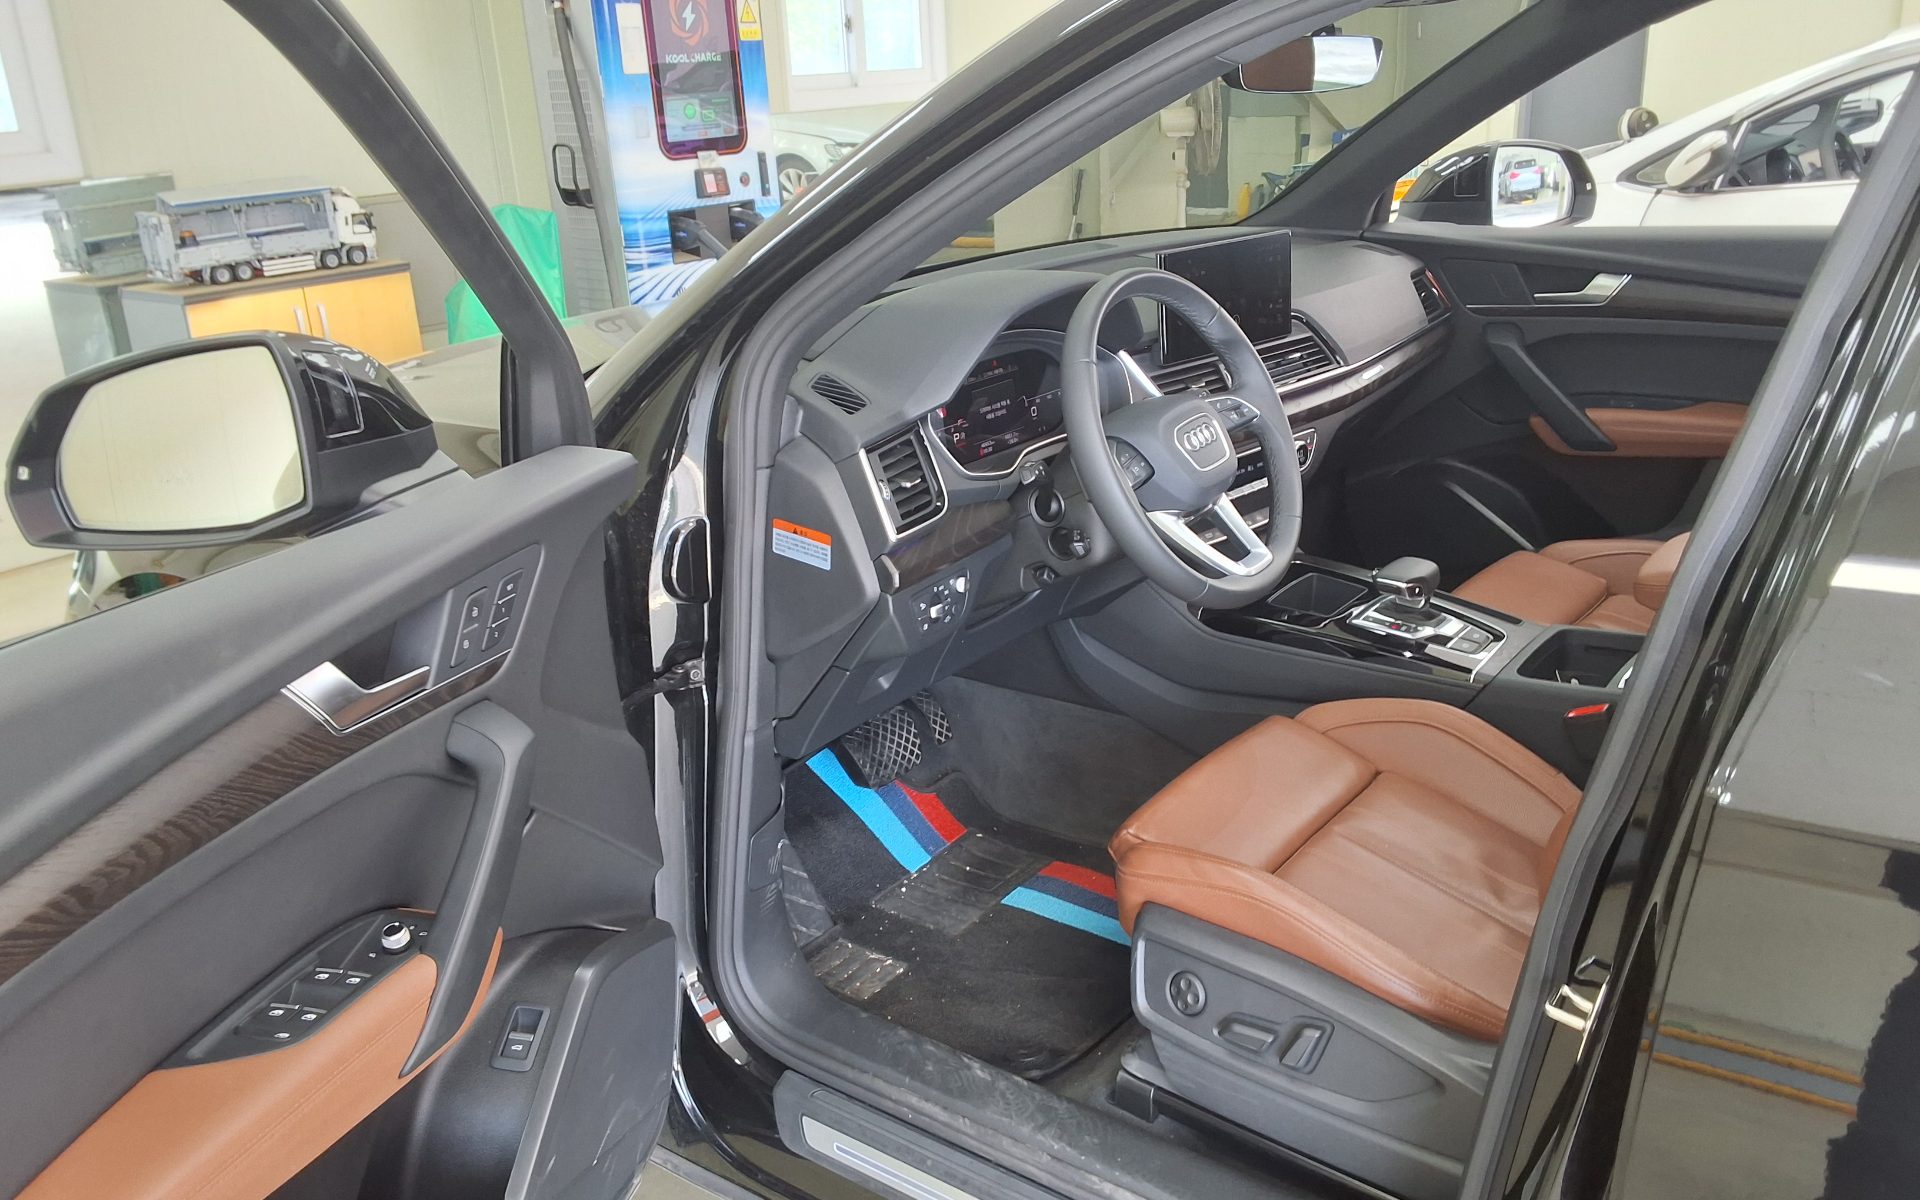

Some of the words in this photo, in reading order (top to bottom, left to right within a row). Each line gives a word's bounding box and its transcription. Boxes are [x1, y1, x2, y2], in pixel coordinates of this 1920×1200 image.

[665, 53, 690, 64] KOOL
[690, 51, 722, 63] CHARGE
[953, 433, 960, 444] P
